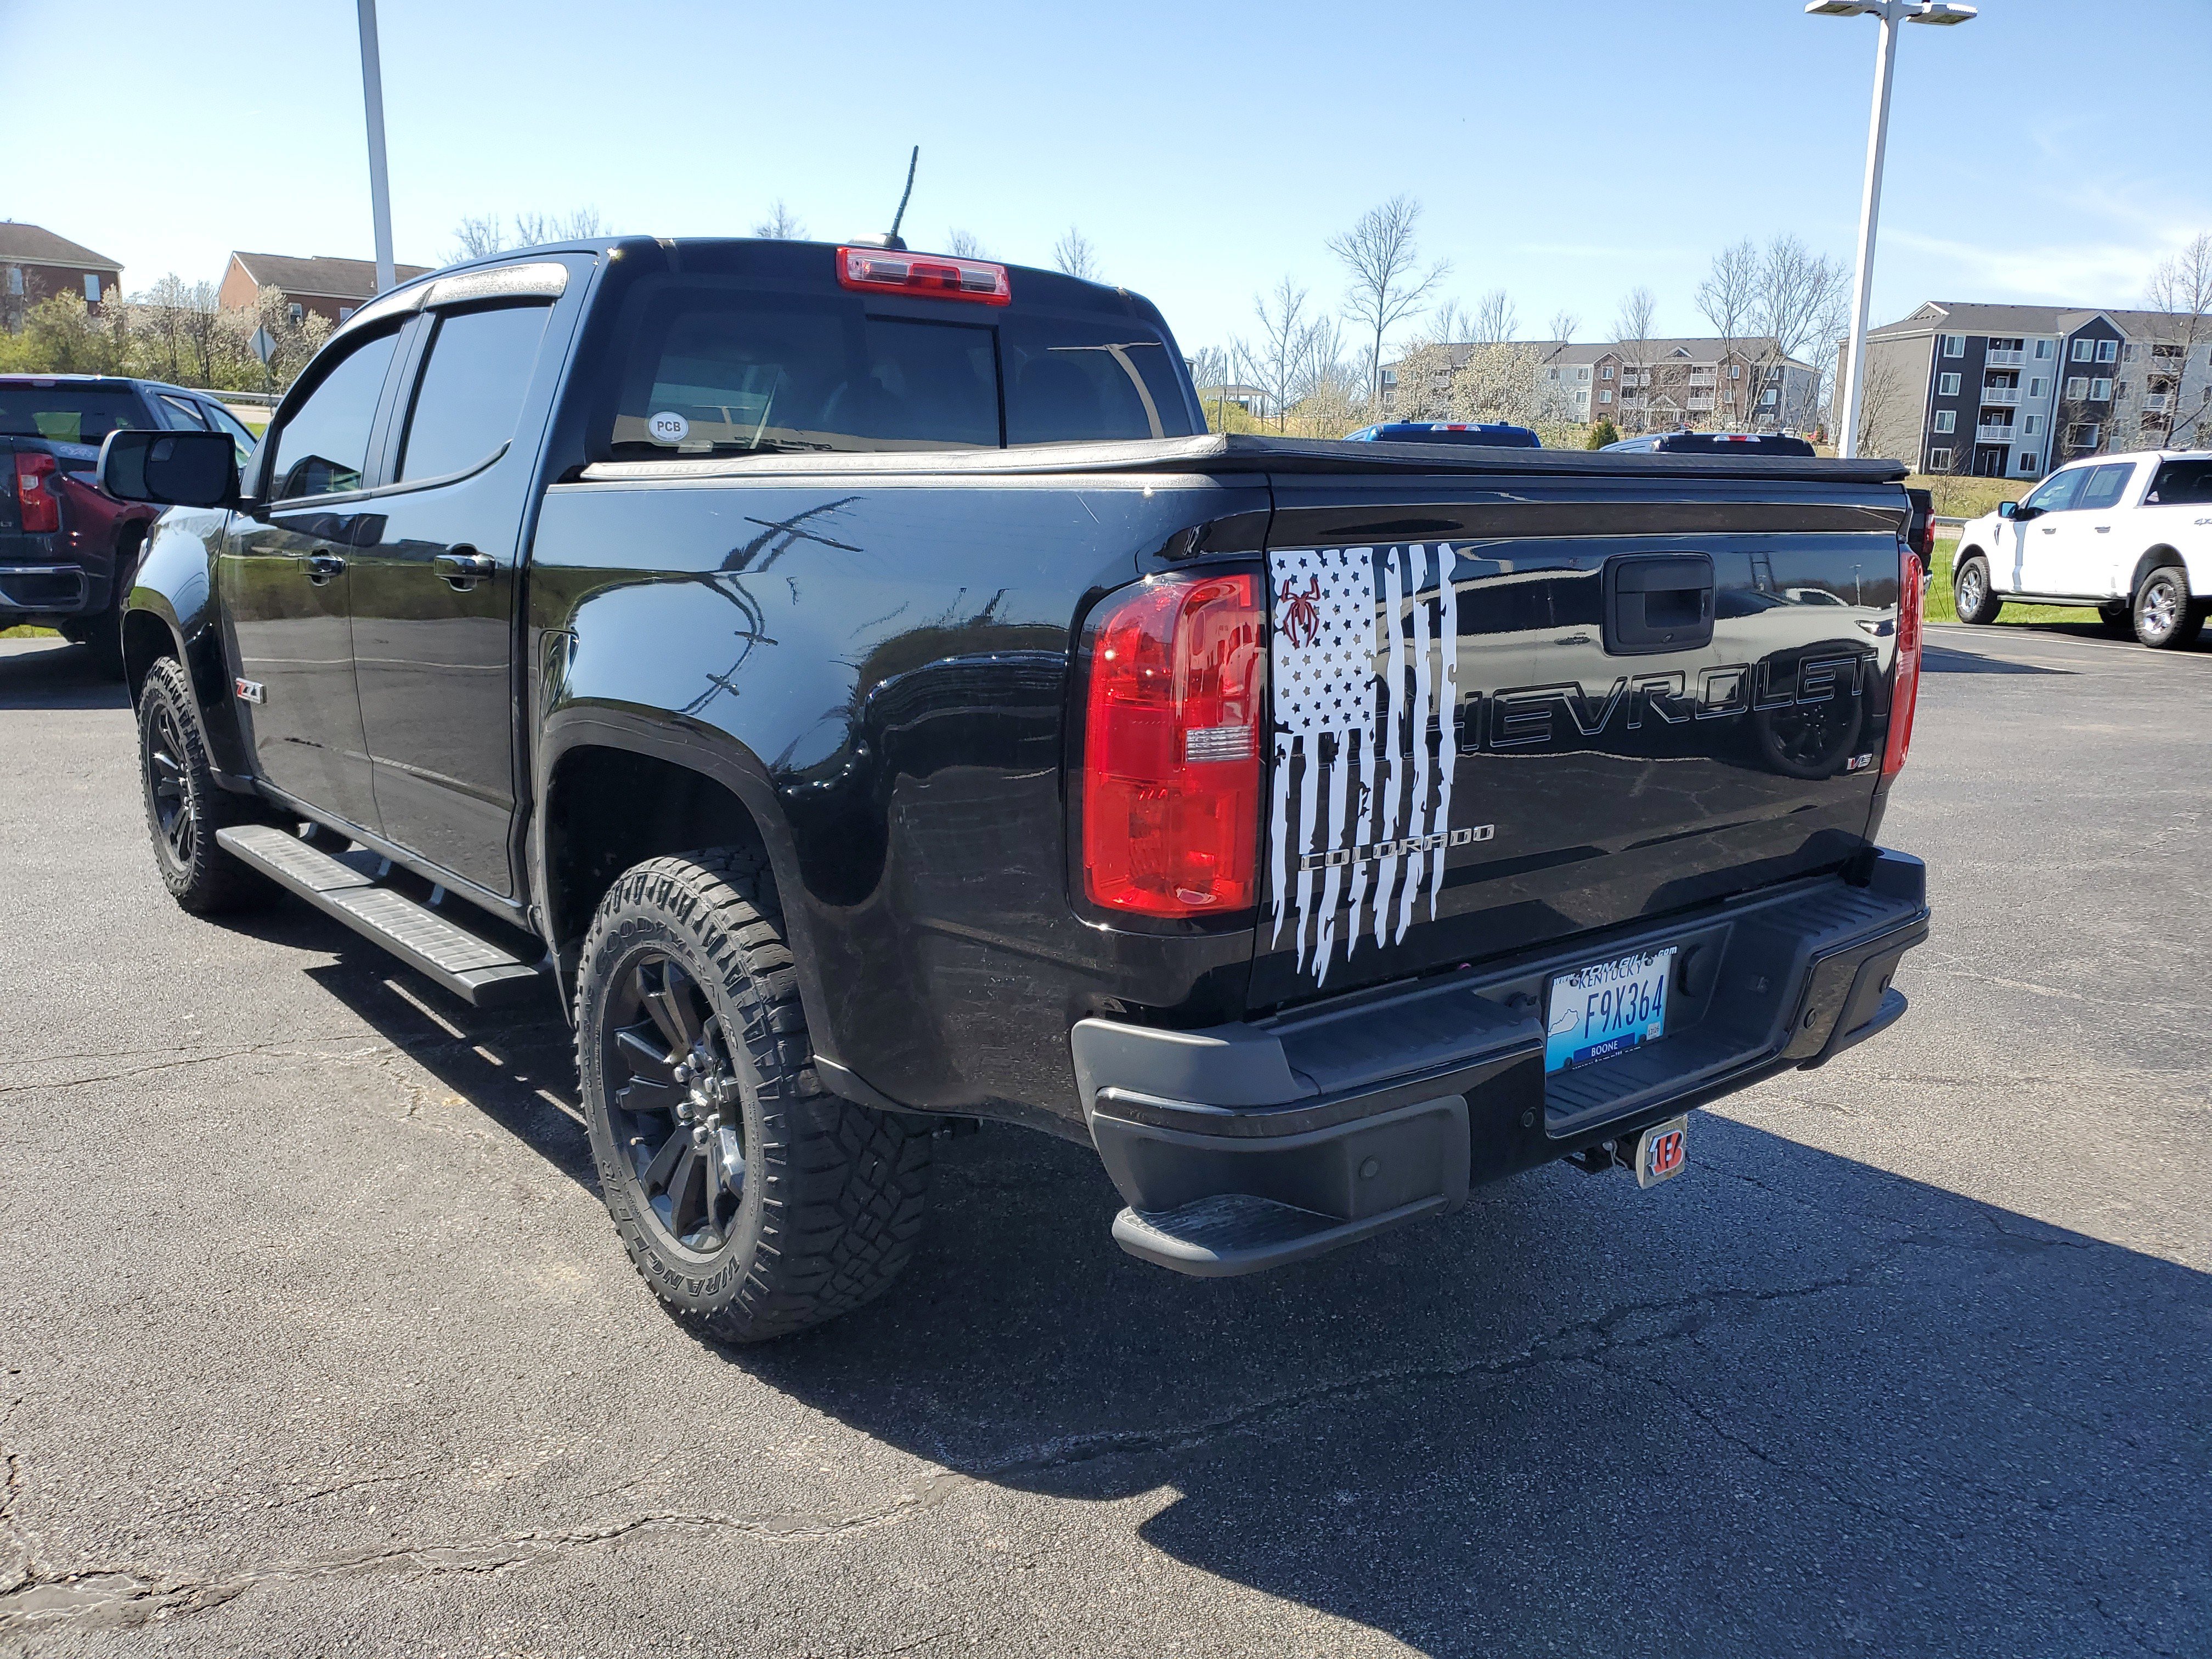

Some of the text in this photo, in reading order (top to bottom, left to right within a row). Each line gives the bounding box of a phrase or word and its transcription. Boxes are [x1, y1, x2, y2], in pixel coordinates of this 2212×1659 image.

[657, 421, 681, 432] PCB
[1846, 753, 1872, 770] V6
[1301, 824, 1494, 871] COLORADO
[1579, 961, 1642, 990] KENTUCKY
[1584, 974, 1664, 1039] F9X364
[1591, 1040, 1618, 1057] BOONE
[1648, 1127, 1684, 1177] B
